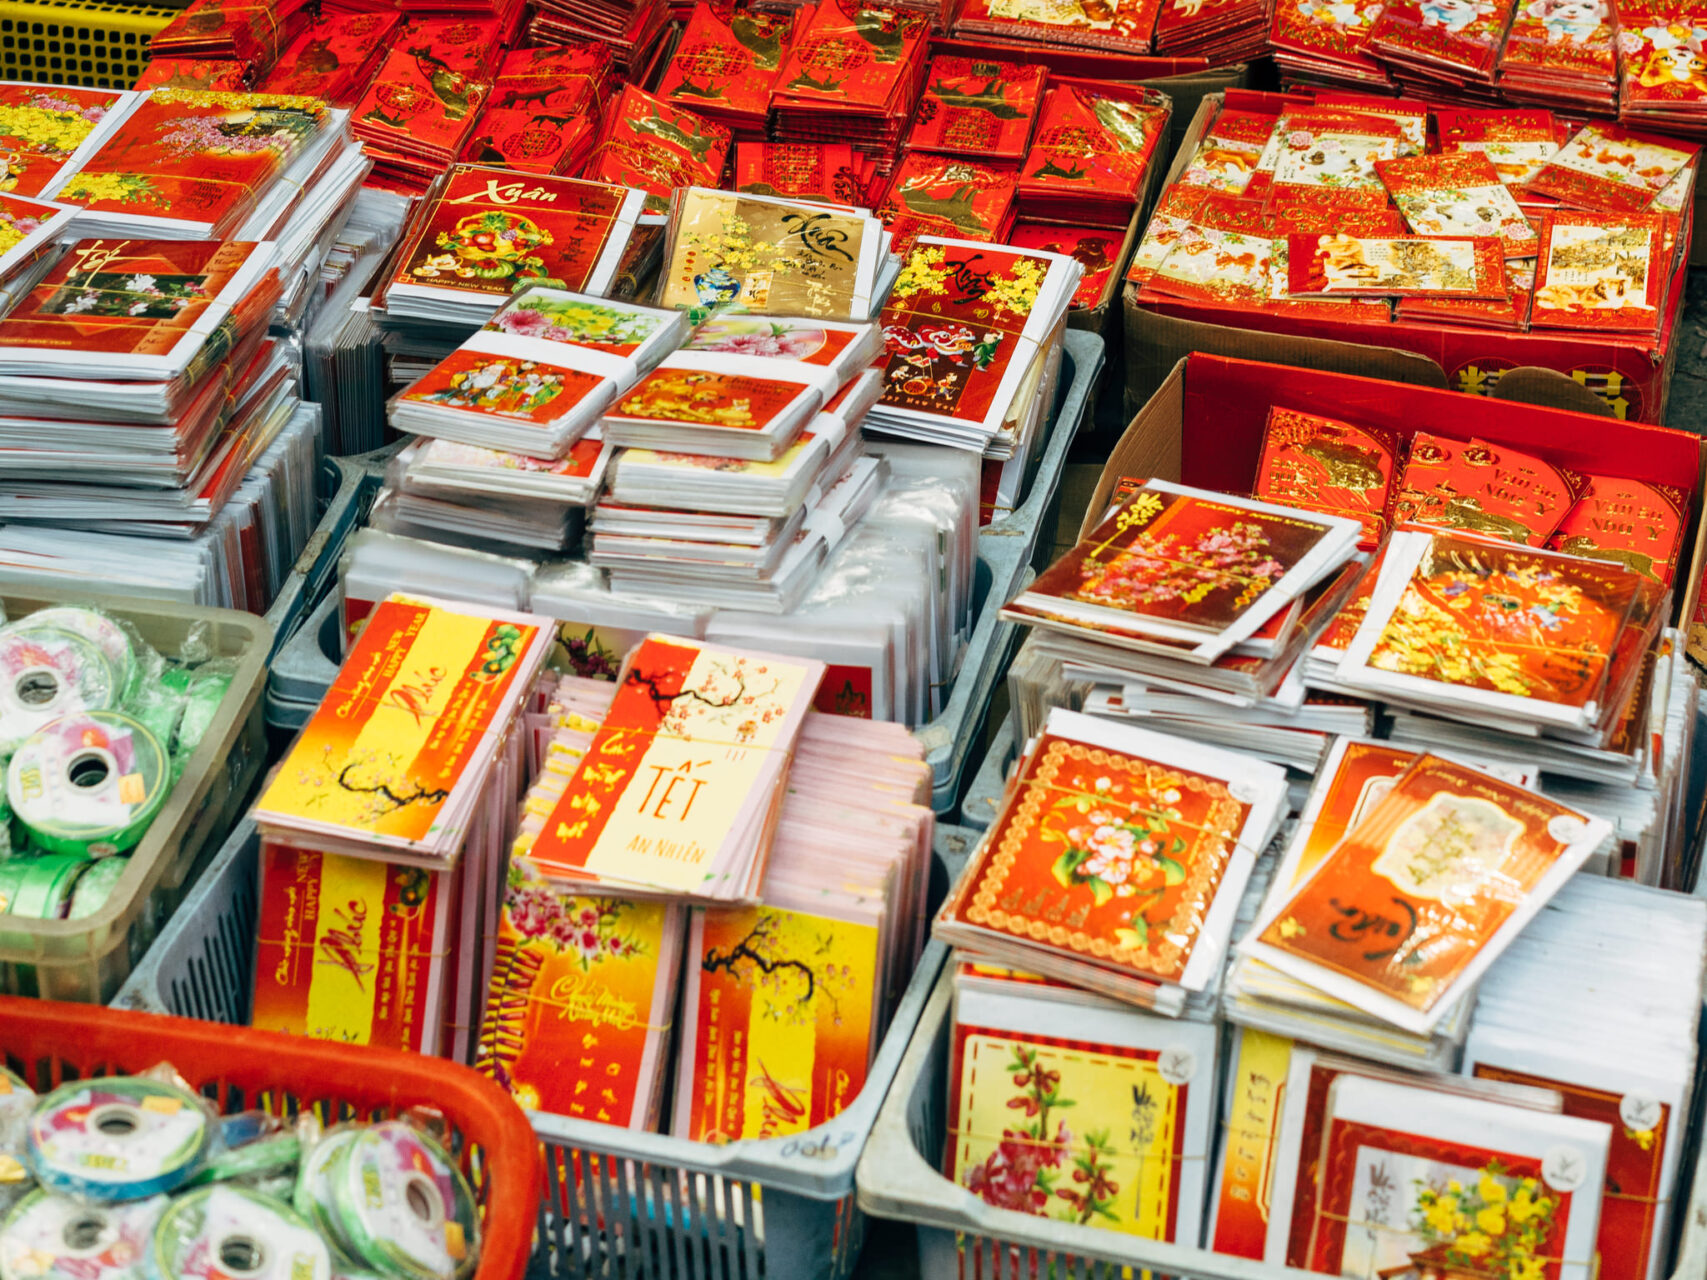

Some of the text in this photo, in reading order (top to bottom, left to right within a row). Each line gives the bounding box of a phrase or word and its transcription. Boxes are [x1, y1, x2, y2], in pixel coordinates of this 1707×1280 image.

[449, 179, 558, 205] Xuân
[426, 277, 505, 292] HAPPY NEW YEAR
[1195, 501, 1246, 516] HAPPY
[1249, 511, 1283, 522] NEW
[405, 611, 427, 637] YEAR
[386, 629, 404, 651] NEW
[382, 647, 407, 678] HAPPY
[638, 759, 714, 822] TẾT
[626, 834, 707, 864] AN NHIÊN
[297, 851, 309, 883] NEW
[305, 877, 319, 920] HAPPY
